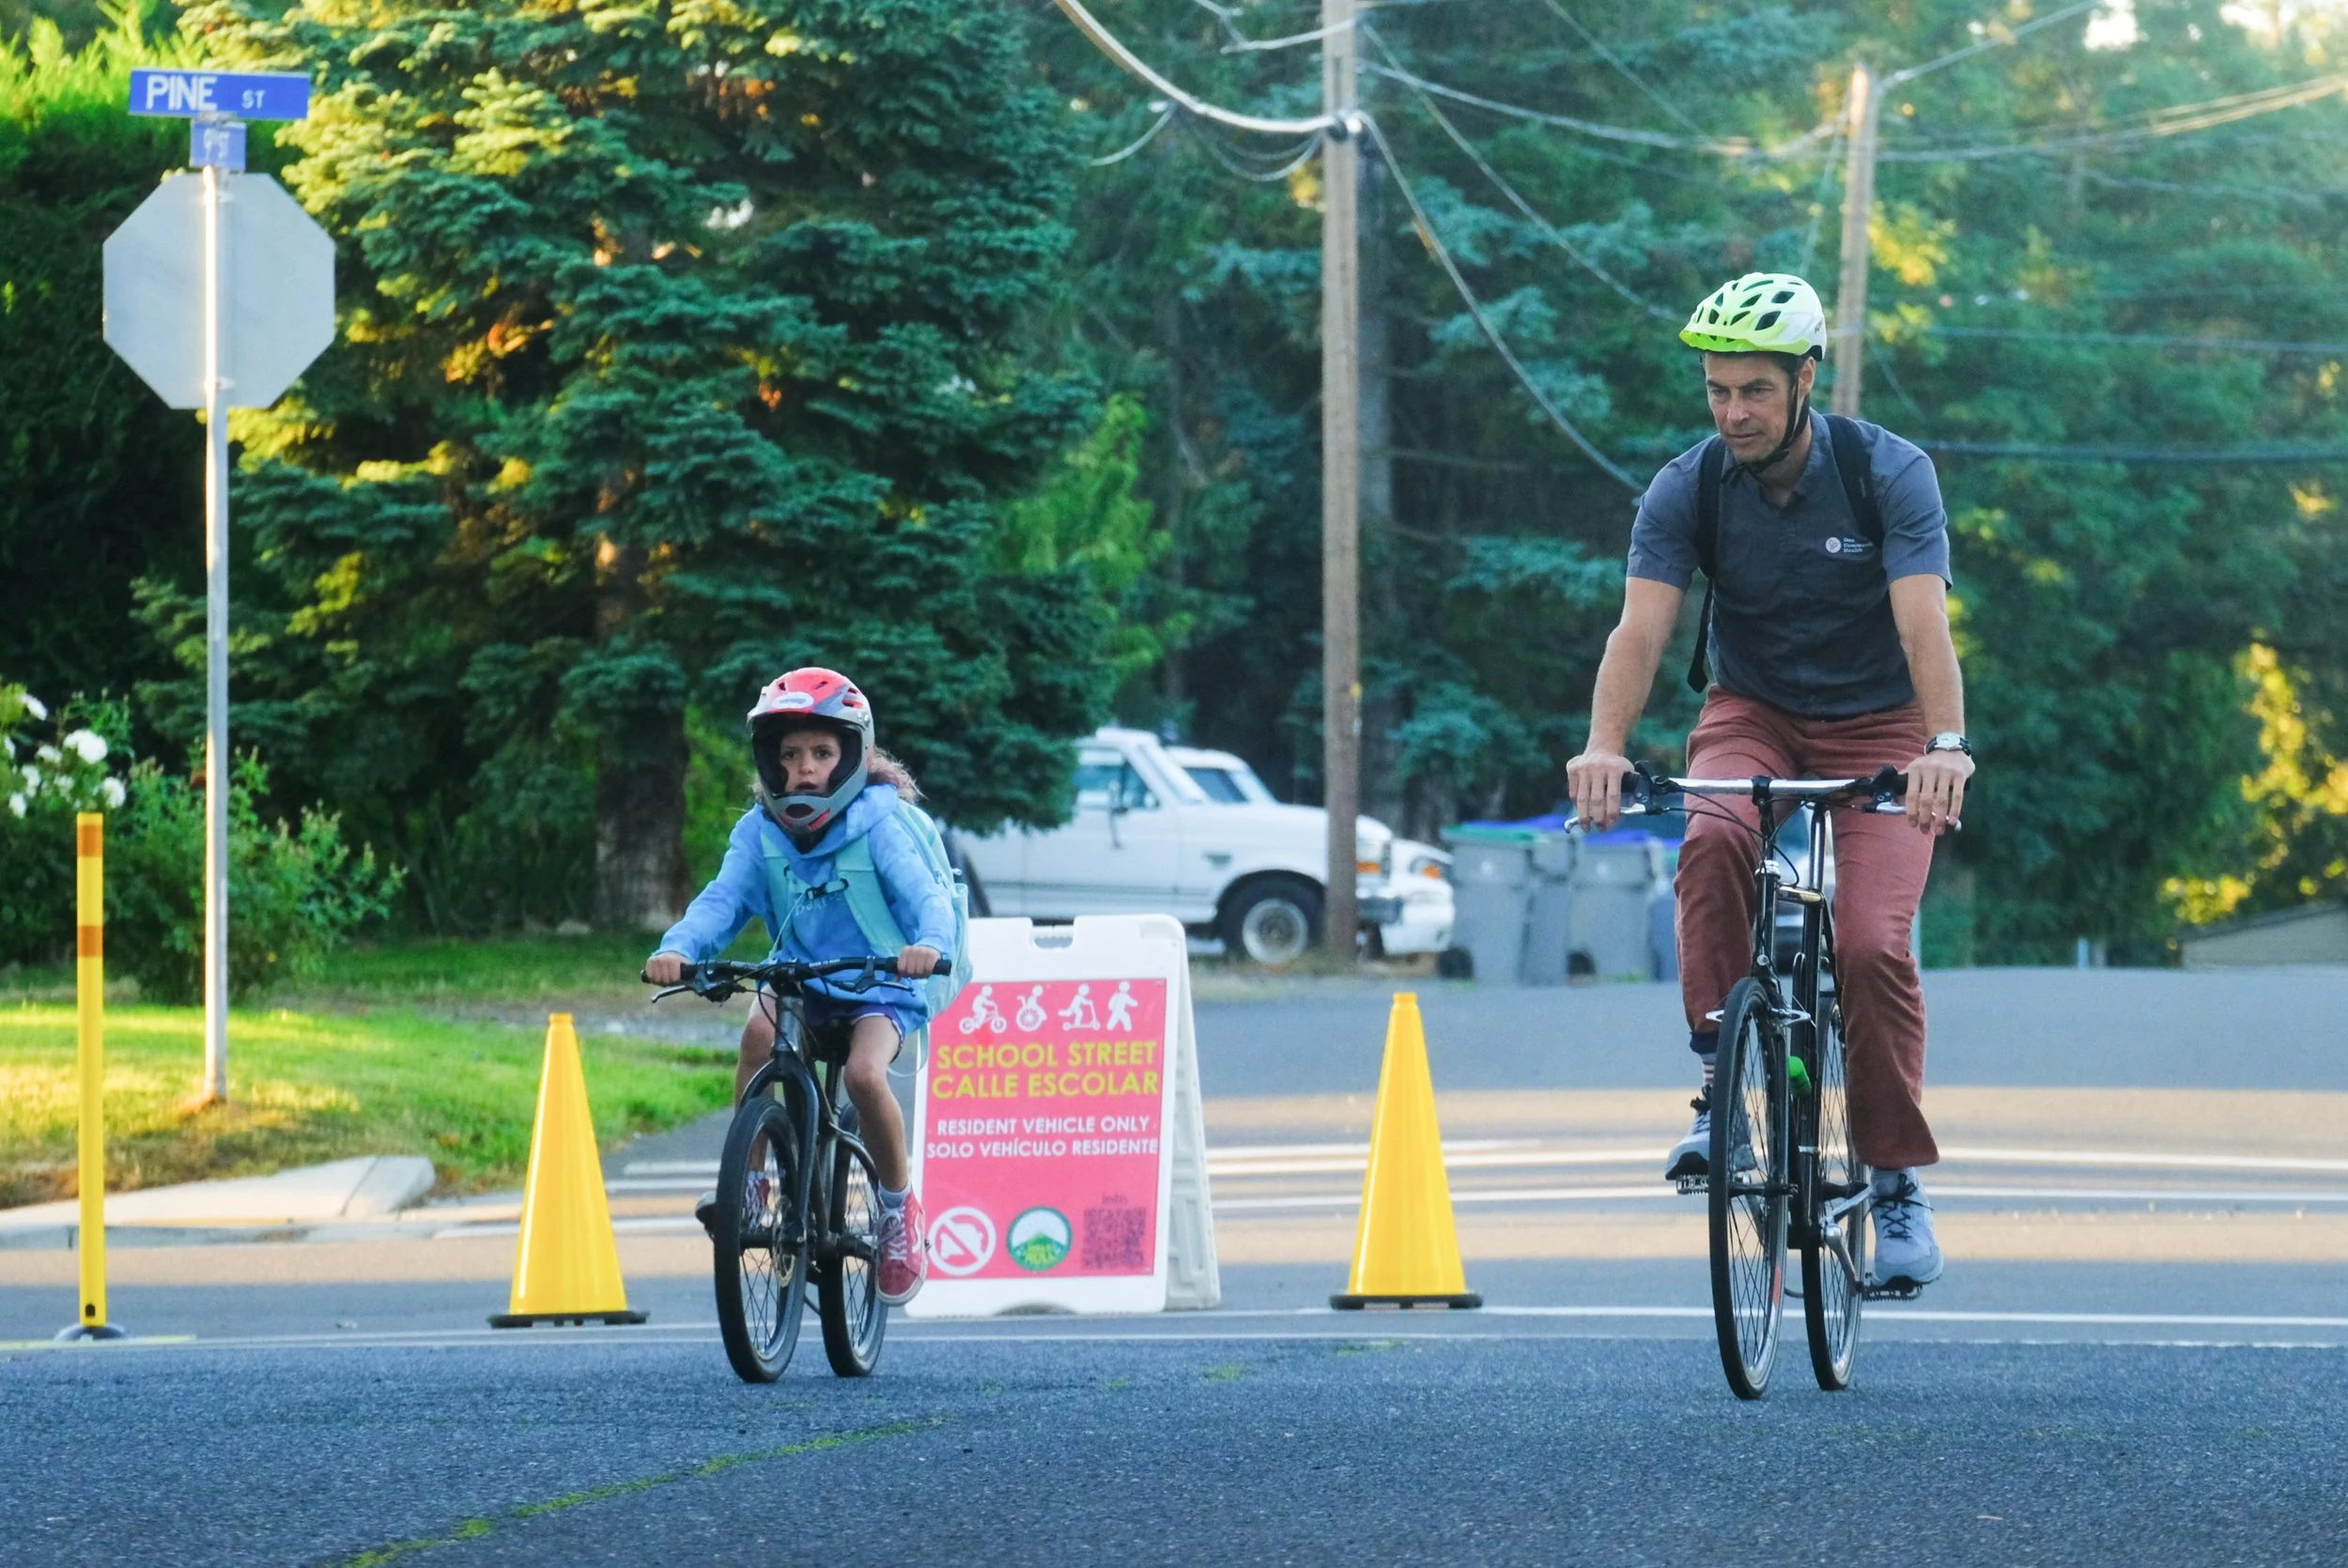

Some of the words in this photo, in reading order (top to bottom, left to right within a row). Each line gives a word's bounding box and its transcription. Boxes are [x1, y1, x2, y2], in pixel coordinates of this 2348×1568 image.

[146, 74, 218, 111] PINE
[241, 89, 265, 110] ST
[936, 1043, 1058, 1069] SCHOOL
[1068, 1041, 1157, 1067] STREET
[932, 1073, 1018, 1099] CALLE
[1028, 1071, 1158, 1097] ESCOLAR
[937, 1118, 1016, 1135] RESIDENT
[1023, 1117, 1095, 1133] VEHICLE
[1101, 1115, 1150, 1132] ONLY
[927, 1142, 974, 1159] SOLO
[980, 1137, 1066, 1157] VEHÍCULO
[1072, 1138, 1158, 1155] RESIDENTE
